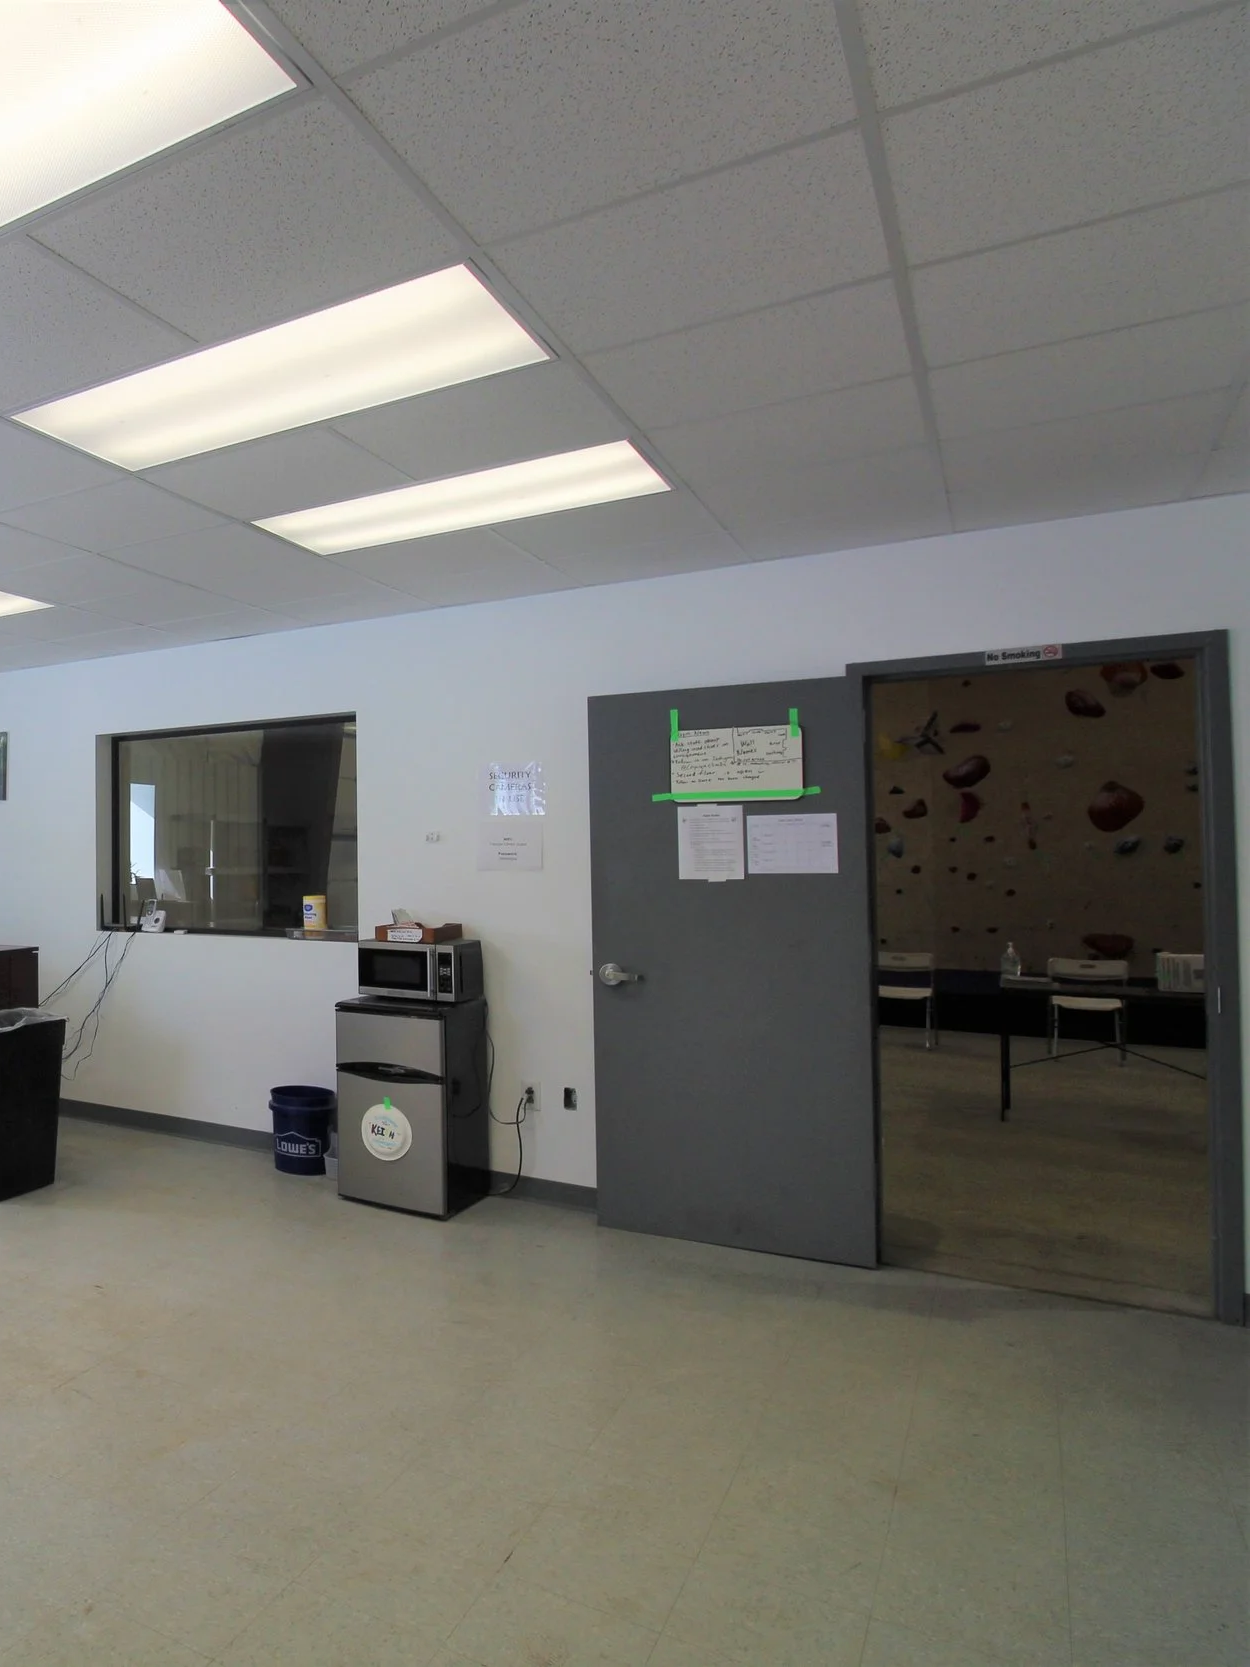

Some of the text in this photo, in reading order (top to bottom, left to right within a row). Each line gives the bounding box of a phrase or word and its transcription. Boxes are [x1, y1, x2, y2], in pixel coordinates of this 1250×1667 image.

[986, 649, 1041, 662] No Smoking
[489, 771, 531, 780] SECURITY
[489, 782, 532, 792] CAMERAS
[508, 794, 526, 803] USE
[371, 1123, 395, 1140] KEIH
[276, 1137, 317, 1155] LOWE'S
